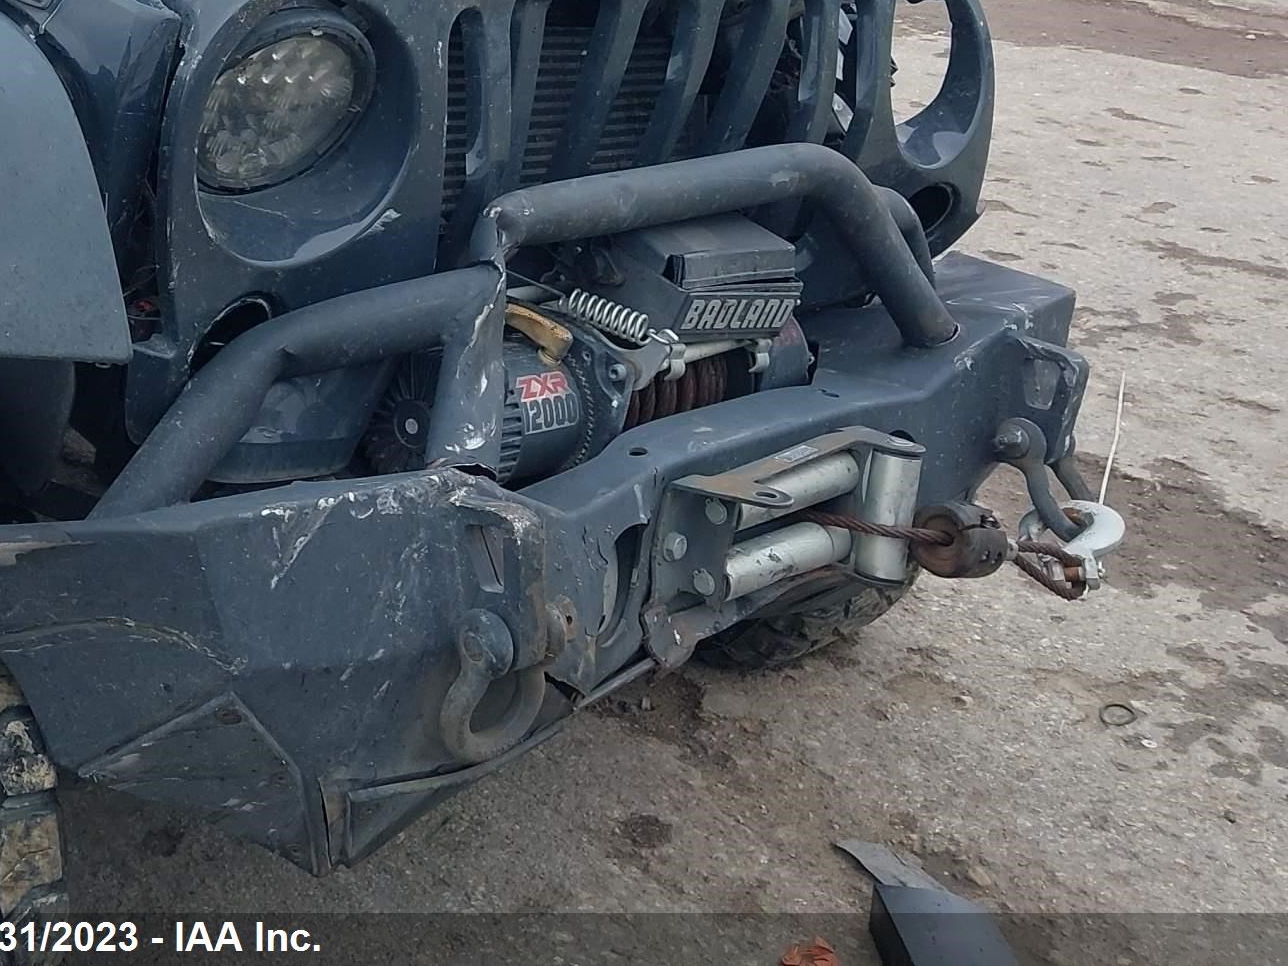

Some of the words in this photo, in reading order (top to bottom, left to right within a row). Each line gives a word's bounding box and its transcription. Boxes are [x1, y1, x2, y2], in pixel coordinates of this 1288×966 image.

[680, 298, 795, 330] BADLAND
[516, 371, 569, 401] ZXR
[521, 394, 578, 434] 12000
